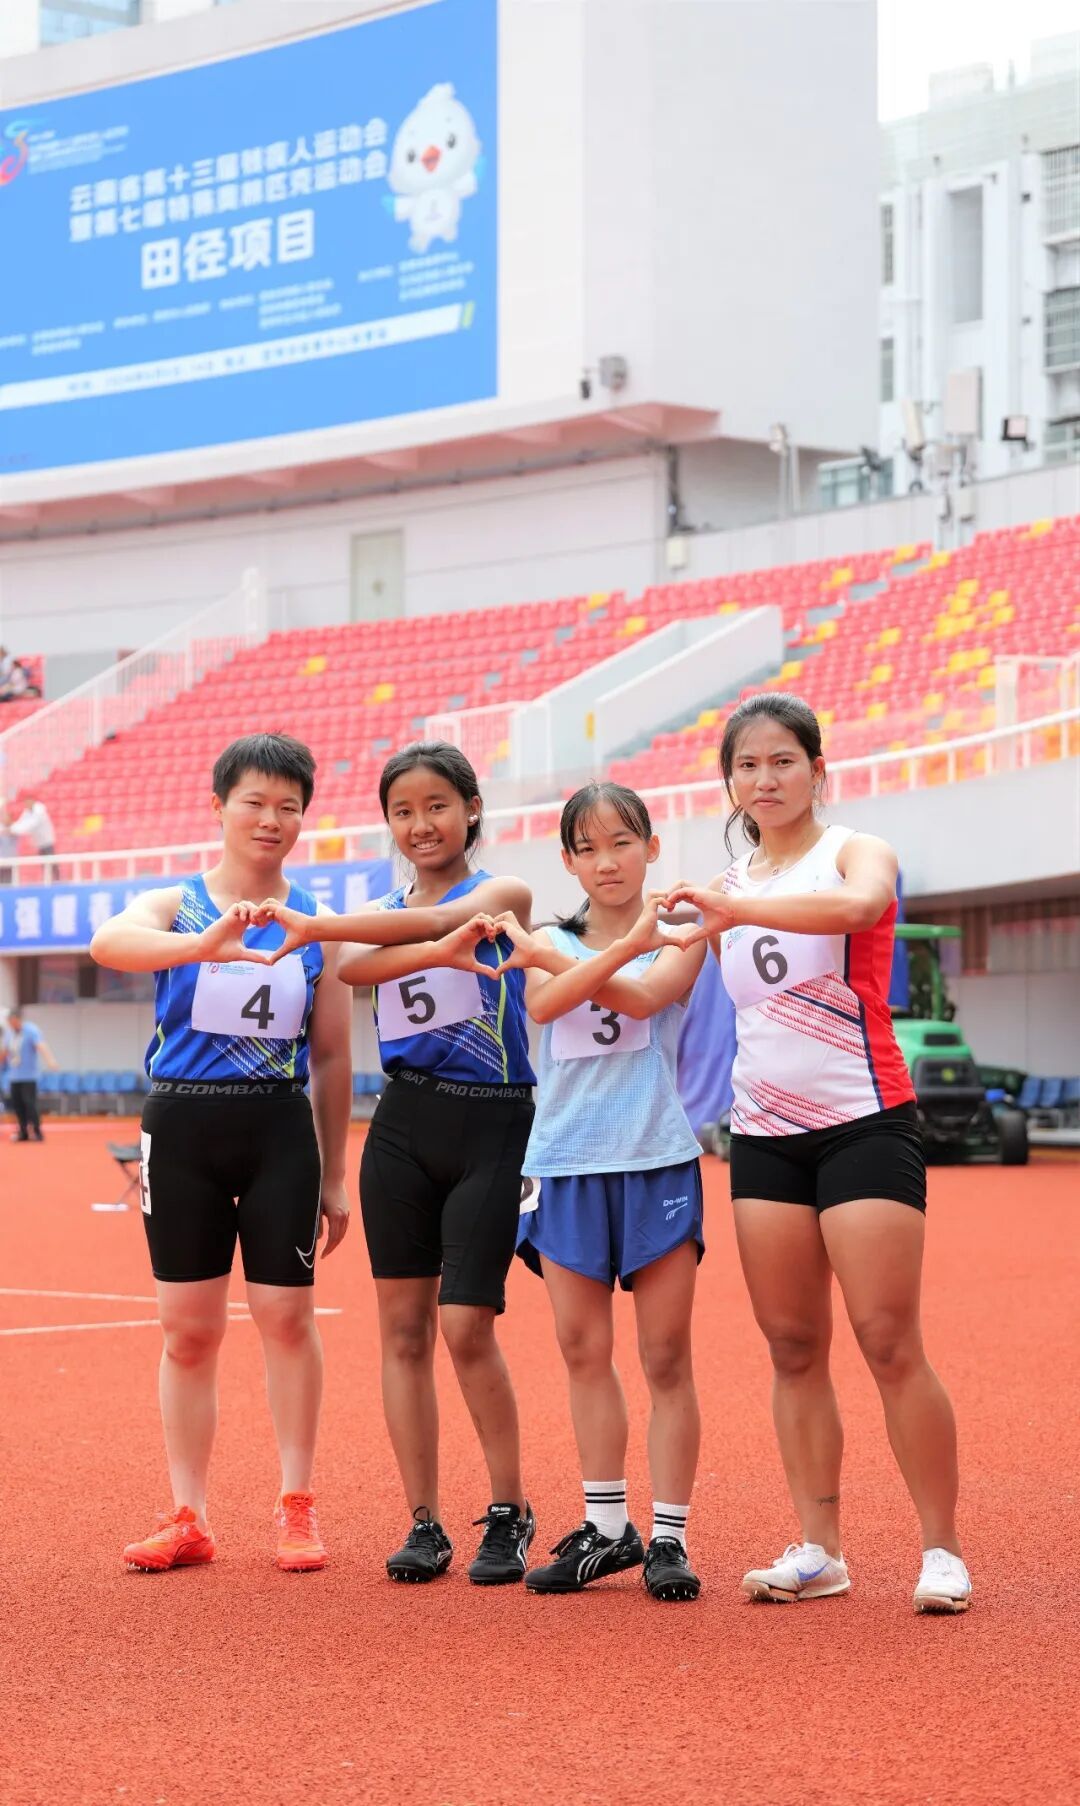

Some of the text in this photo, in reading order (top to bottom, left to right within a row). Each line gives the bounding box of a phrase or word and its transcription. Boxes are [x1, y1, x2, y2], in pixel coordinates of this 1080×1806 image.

[141, 208, 315, 289] 田径项目
[752, 934, 788, 985] 6
[241, 984, 275, 1030] 4
[399, 976, 437, 1025] 5
[592, 1001, 622, 1046] 3
[175, 1083, 278, 1095] COMBAT
[436, 1081, 527, 1098] PRO COMBAT
